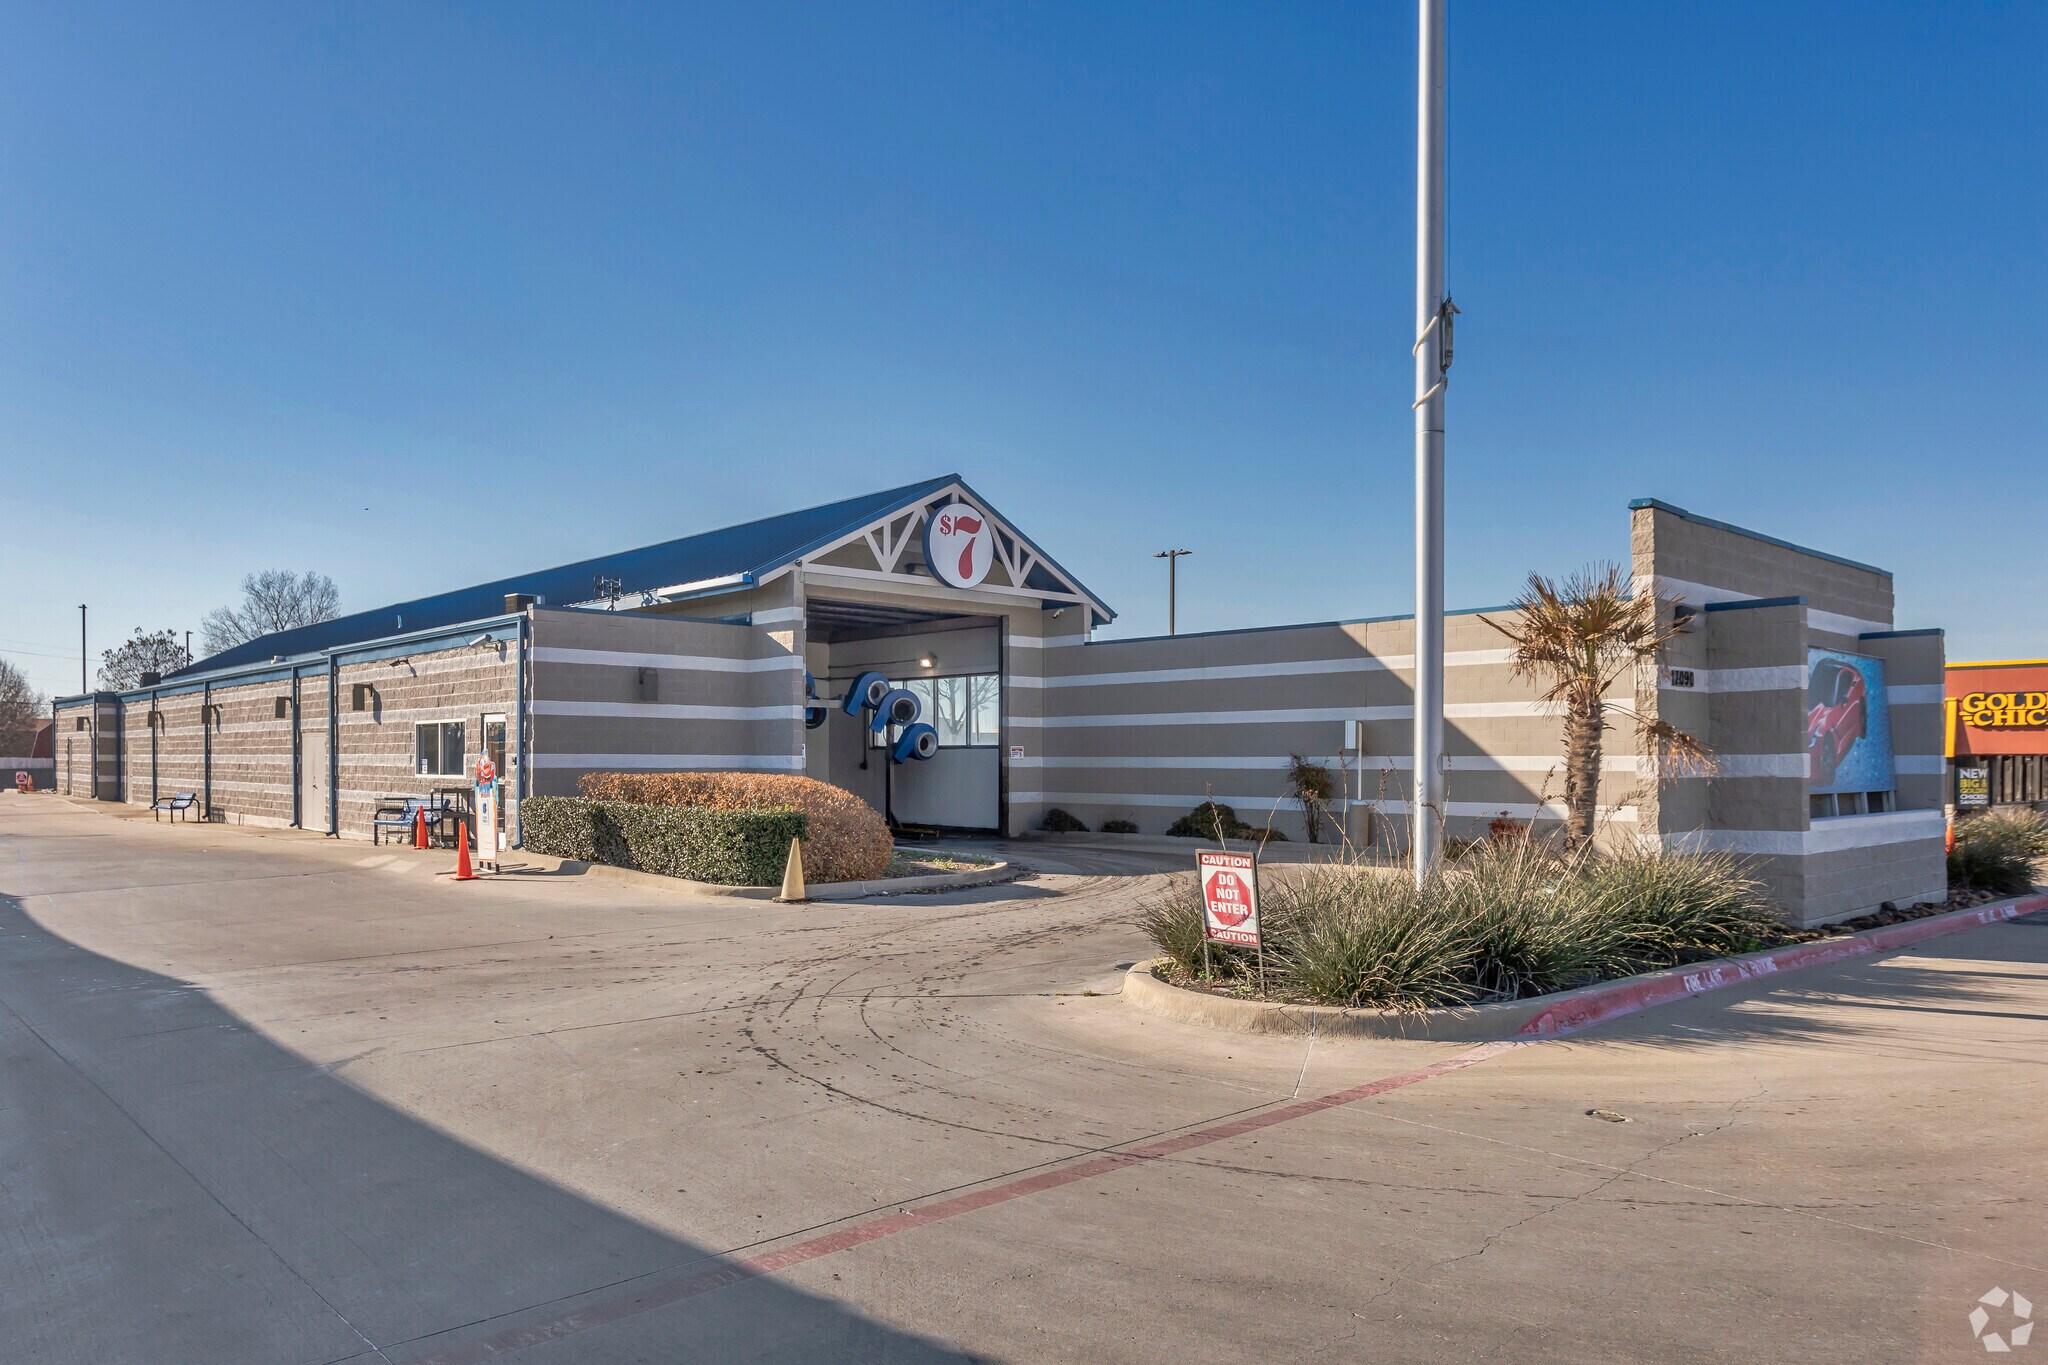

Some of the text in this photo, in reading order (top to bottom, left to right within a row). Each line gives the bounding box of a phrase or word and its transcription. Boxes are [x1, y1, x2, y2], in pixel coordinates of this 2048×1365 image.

[940, 514, 982, 579] $7
[1962, 692, 2048, 713] GOLD
[1973, 709, 2048, 726] CHIC
[1960, 768, 1988, 778] NEW
[1960, 779, 1980, 788] BIG
[1202, 855, 1250, 867] CAUTION
[1218, 874, 1235, 886] DO
[1216, 887, 1239, 900] NOT
[1210, 900, 1248, 915] ENTER
[1210, 929, 1257, 943] CAUTION
